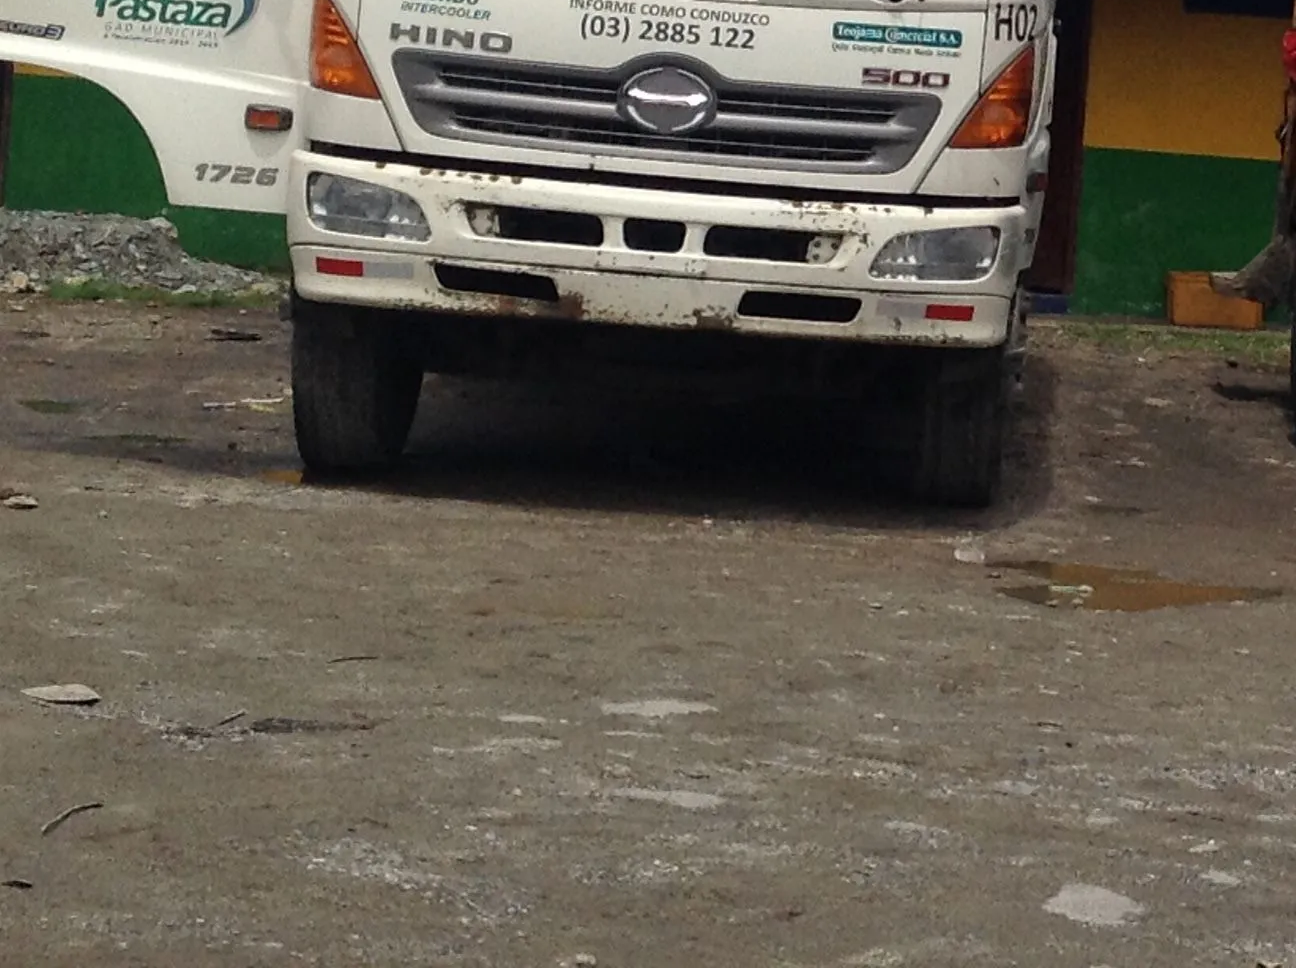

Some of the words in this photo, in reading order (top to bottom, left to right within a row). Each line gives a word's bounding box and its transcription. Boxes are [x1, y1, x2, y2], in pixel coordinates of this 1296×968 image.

[401, 1, 491, 21] INTERCOOLER
[640, 3, 686, 18] COMO
[690, 8, 770, 26] CONDUZCO
[994, 2, 1038, 42] H02
[104, 22, 133, 33] GAD
[141, 25, 219, 40] MUNICIPAL
[390, 22, 513, 53] HINO
[580, 13, 630, 44] (03)
[638, 19, 701, 45] 2885
[709, 26, 755, 50] 122
[862, 67, 950, 87] 500
[195, 163, 279, 186] 1726
